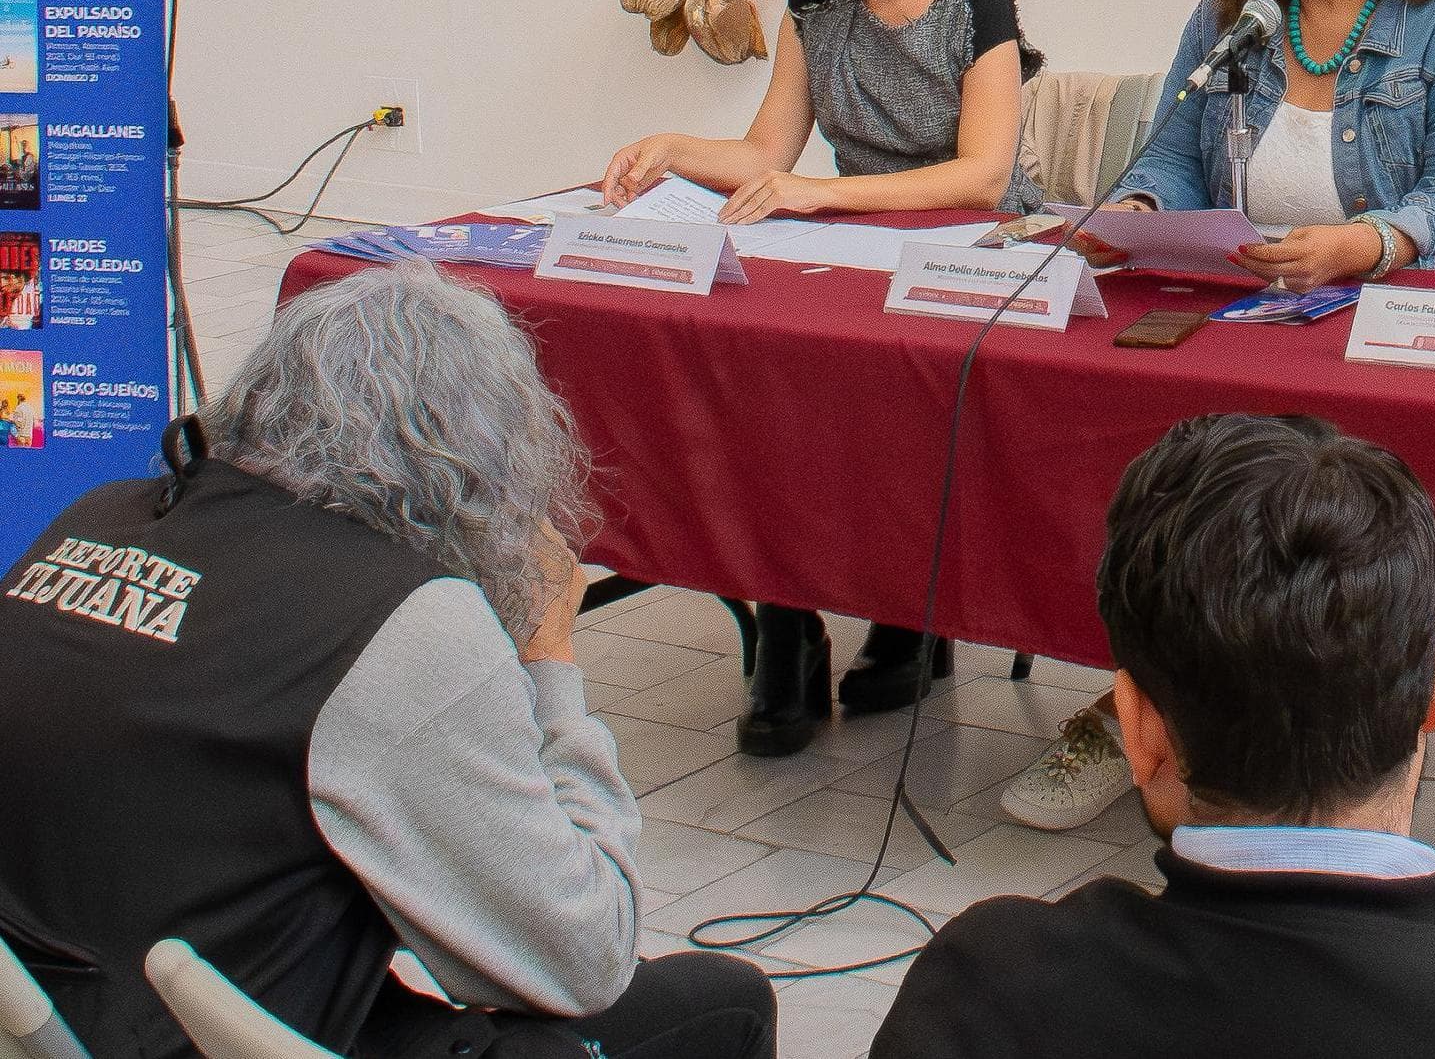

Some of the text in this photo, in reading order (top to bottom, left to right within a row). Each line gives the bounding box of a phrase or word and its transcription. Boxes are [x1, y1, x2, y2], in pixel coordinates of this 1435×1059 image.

[45, 6, 133, 20] EXPULSADO
[45, 23, 142, 39] DEL PARAÍSO
[47, 124, 145, 139] MAGALLANES
[49, 239, 107, 253] TARDES
[50, 258, 143, 273] DE SOLEDAD
[1385, 300, 1419, 314] Carlos
[52, 362, 97, 377] AMOR
[53, 381, 159, 402] (SEXO-SUEÑOS)
[46, 537, 202, 600] REPORTE
[6, 562, 188, 643] TIJUANA
